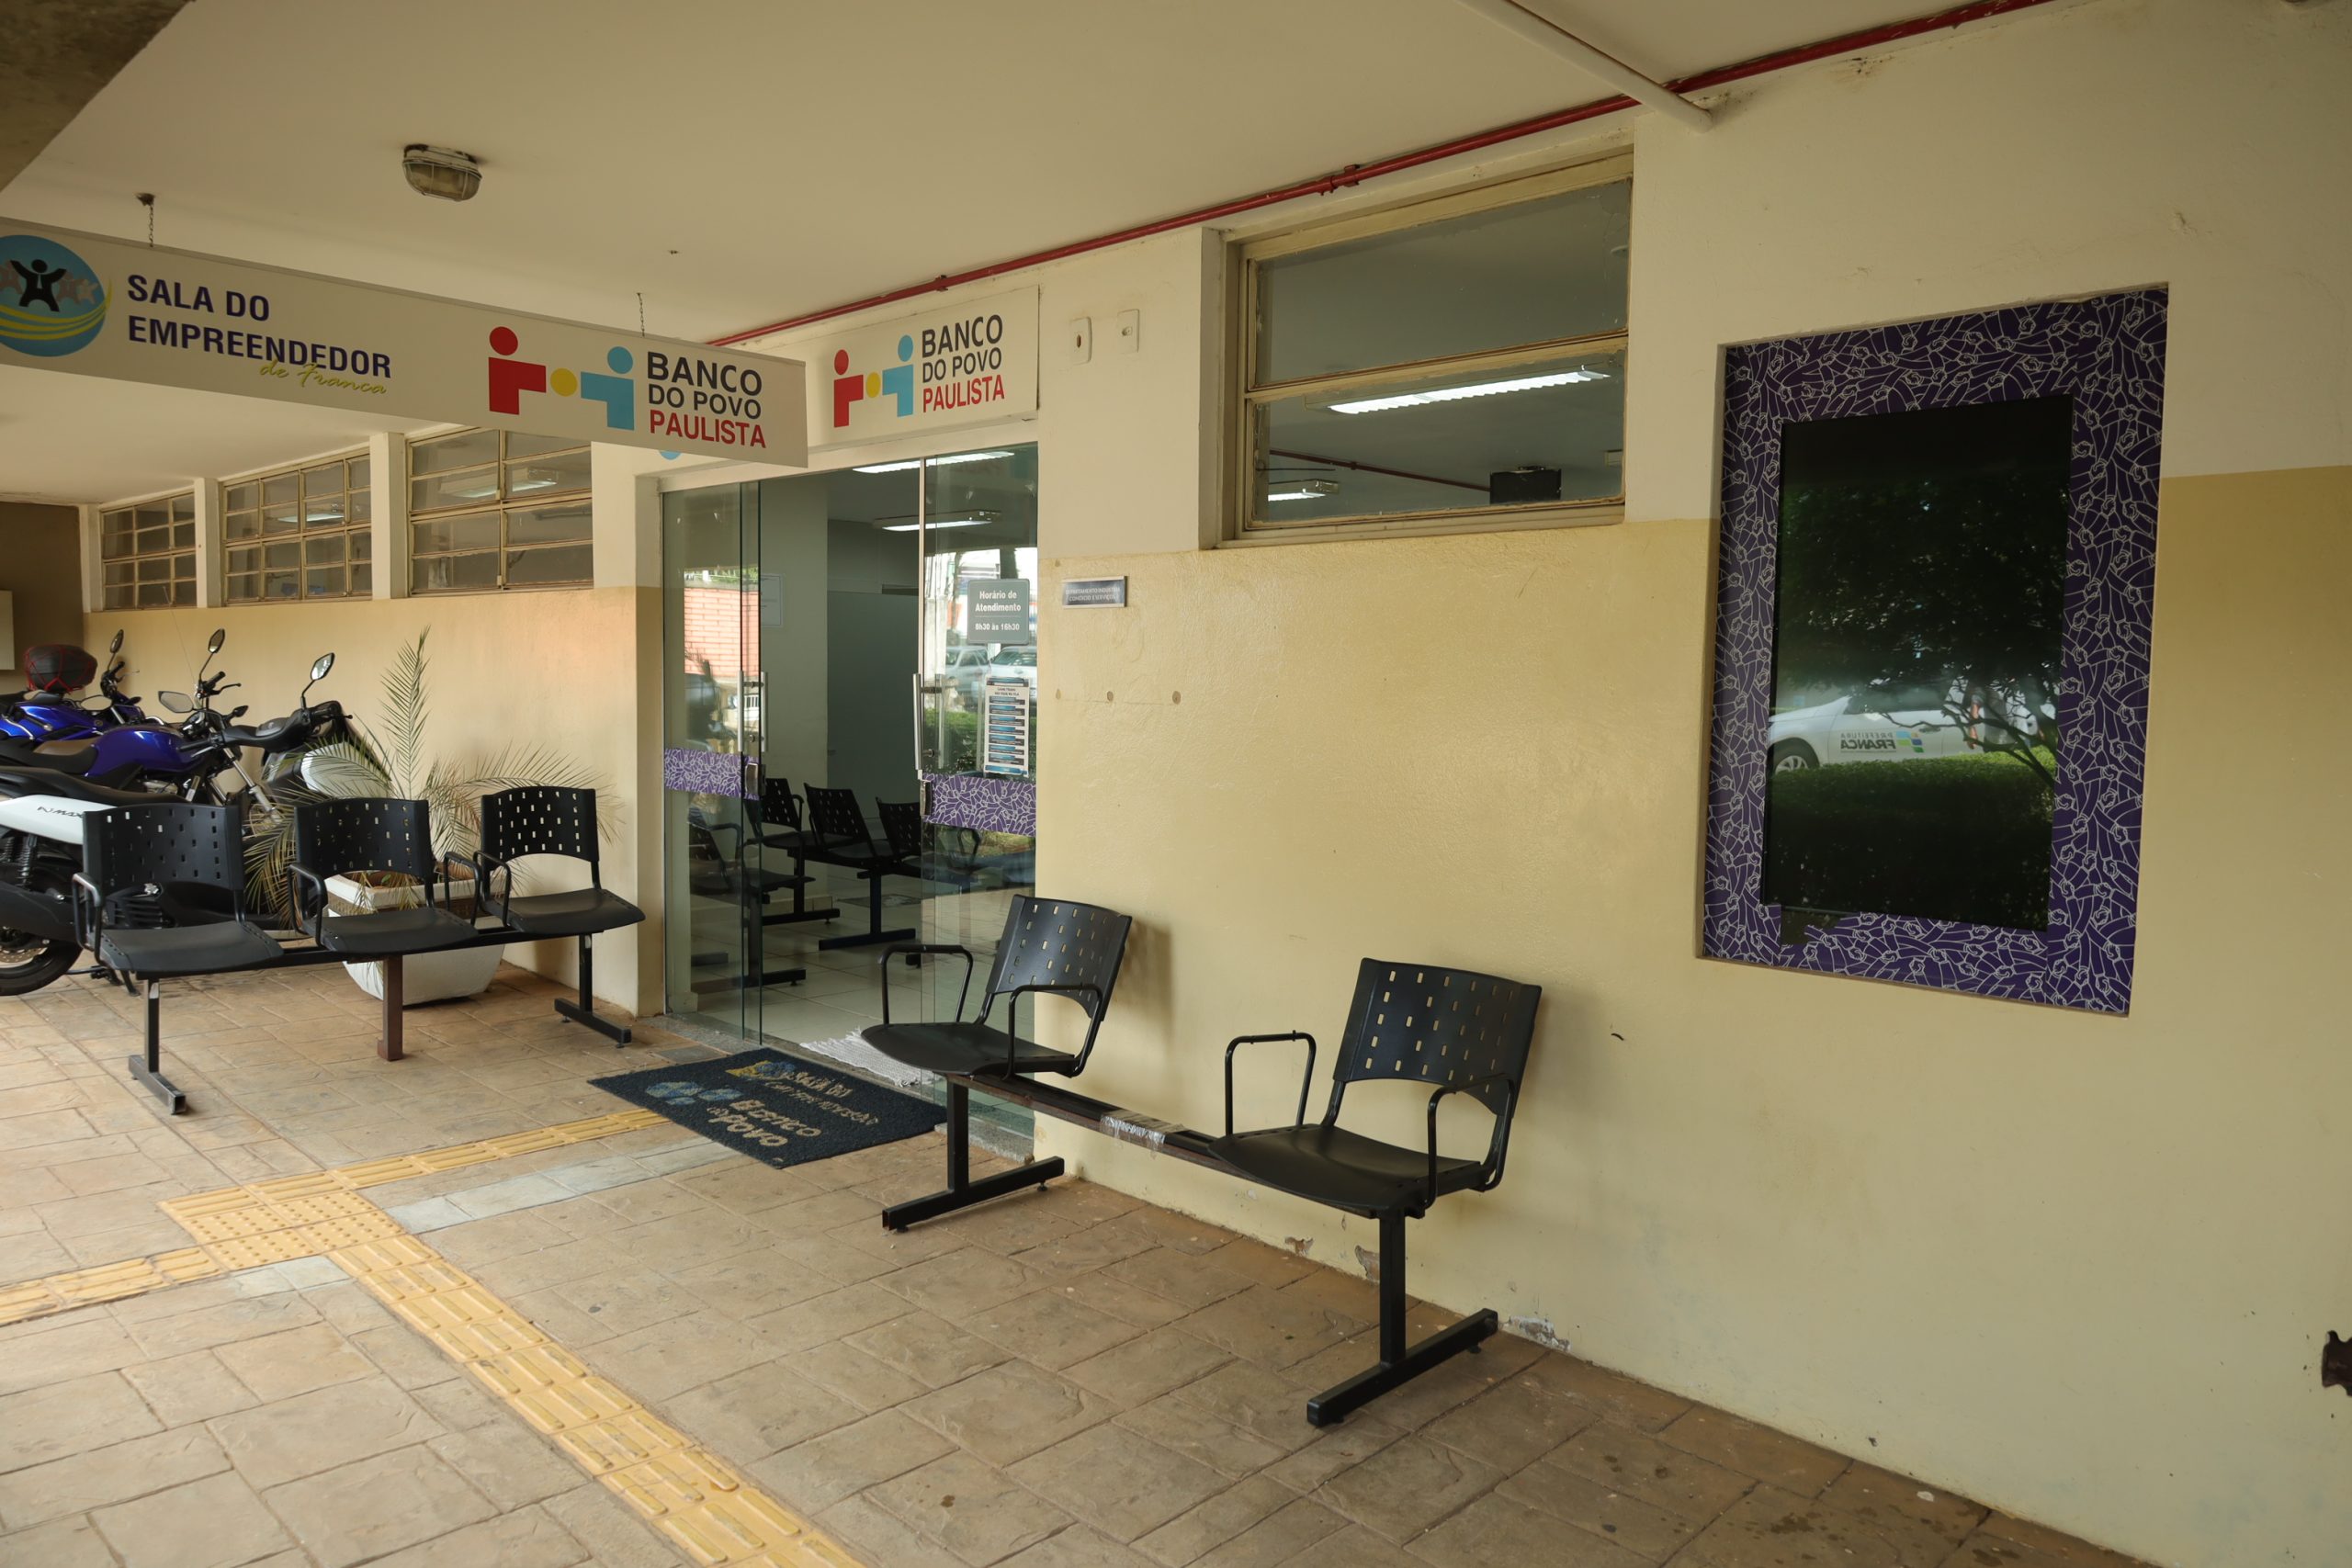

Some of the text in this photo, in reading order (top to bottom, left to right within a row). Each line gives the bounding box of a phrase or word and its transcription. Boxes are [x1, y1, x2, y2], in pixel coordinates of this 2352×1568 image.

[128, 275, 269, 321] SALA DO
[129, 315, 391, 378] EMPREENDEDOR
[922, 314, 1003, 358] BANCO
[259, 359, 387, 394] de Franca
[648, 351, 762, 396] BANCO
[922, 347, 1002, 383] DO POVO
[649, 383, 762, 420] DO POVO
[923, 374, 1005, 413] PAULISTA
[650, 409, 766, 449] PAULISTA
[975, 603, 1022, 612] Atendimento
[979, 590, 1017, 600] Horário de
[975, 623, 990, 631] 8h30
[1001, 623, 1020, 631] 16h30
